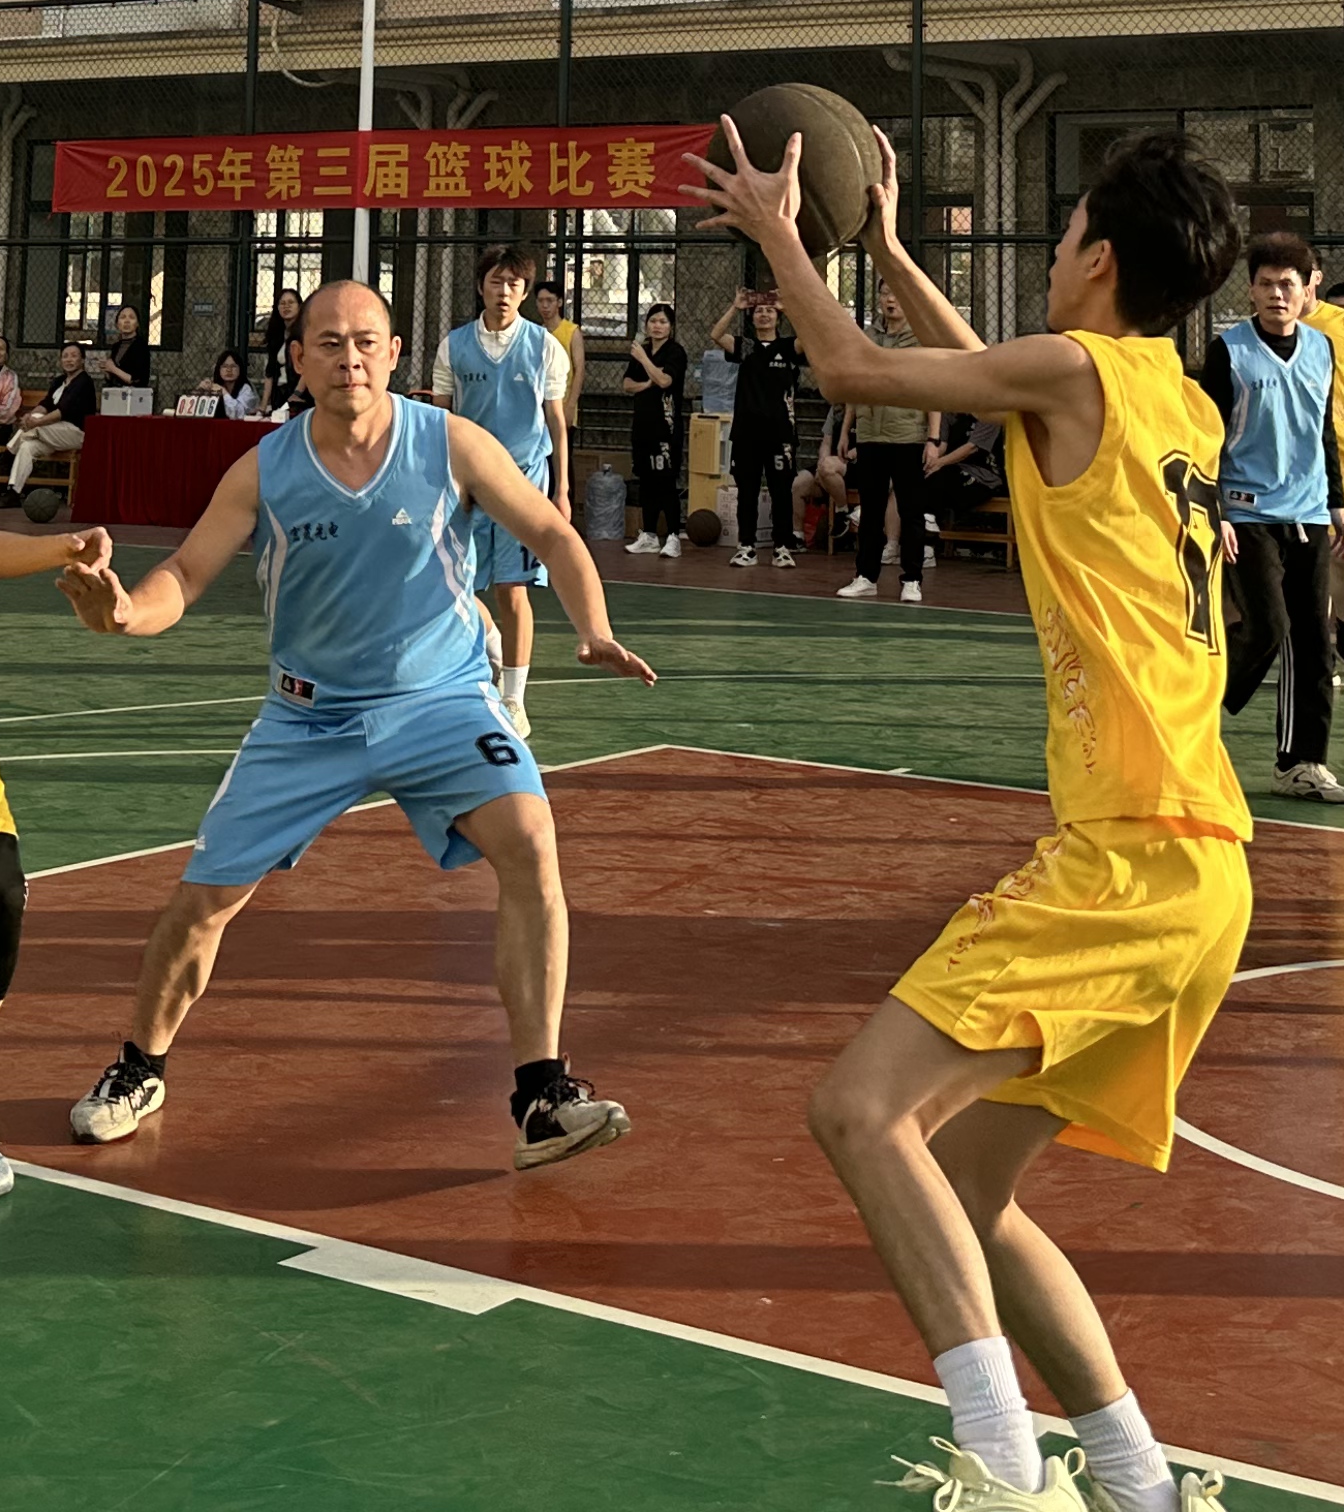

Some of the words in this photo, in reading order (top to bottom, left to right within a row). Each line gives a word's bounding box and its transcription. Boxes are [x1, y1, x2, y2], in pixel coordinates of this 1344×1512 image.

[106, 138, 657, 201] 2025年第三届篮球比赛
[649, 453, 665, 471] 18
[774, 454, 784, 471] 5
[474, 731, 522, 767] 6
